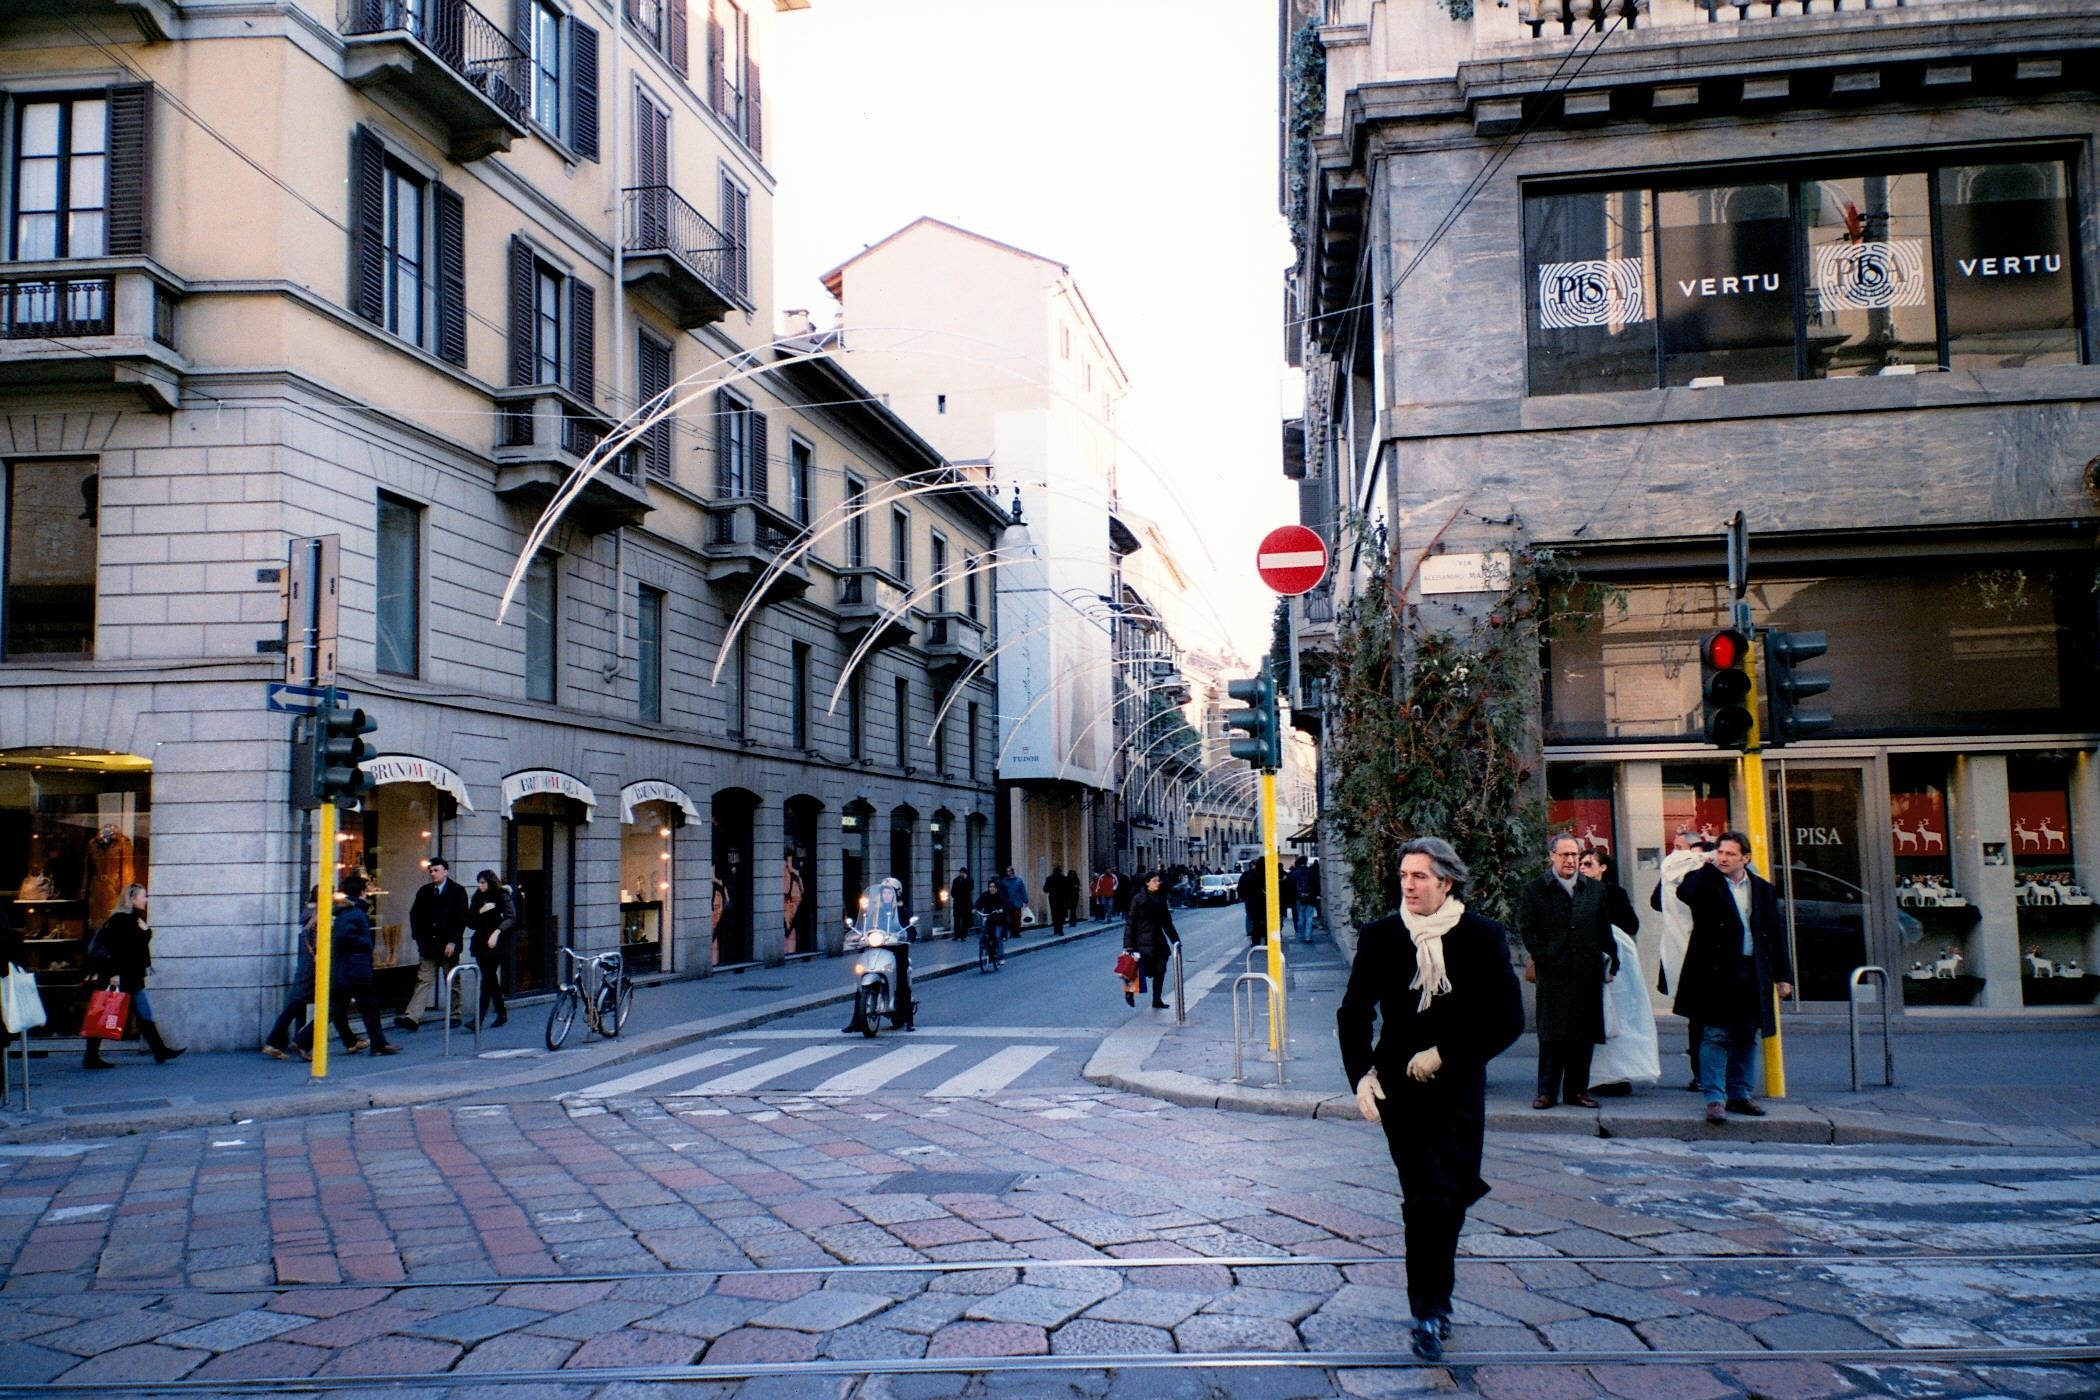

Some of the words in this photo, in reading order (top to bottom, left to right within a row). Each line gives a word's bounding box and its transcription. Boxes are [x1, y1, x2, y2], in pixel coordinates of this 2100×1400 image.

[1832, 254, 1908, 287] PISA
[1959, 254, 2061, 277] VERTU
[1556, 271, 1627, 304] PISA
[1678, 273, 1780, 297] VERTU
[1012, 755, 1040, 764] TUDOR
[370, 762, 447, 786] BRUNOMGLI
[1795, 827, 1843, 846] PISA
